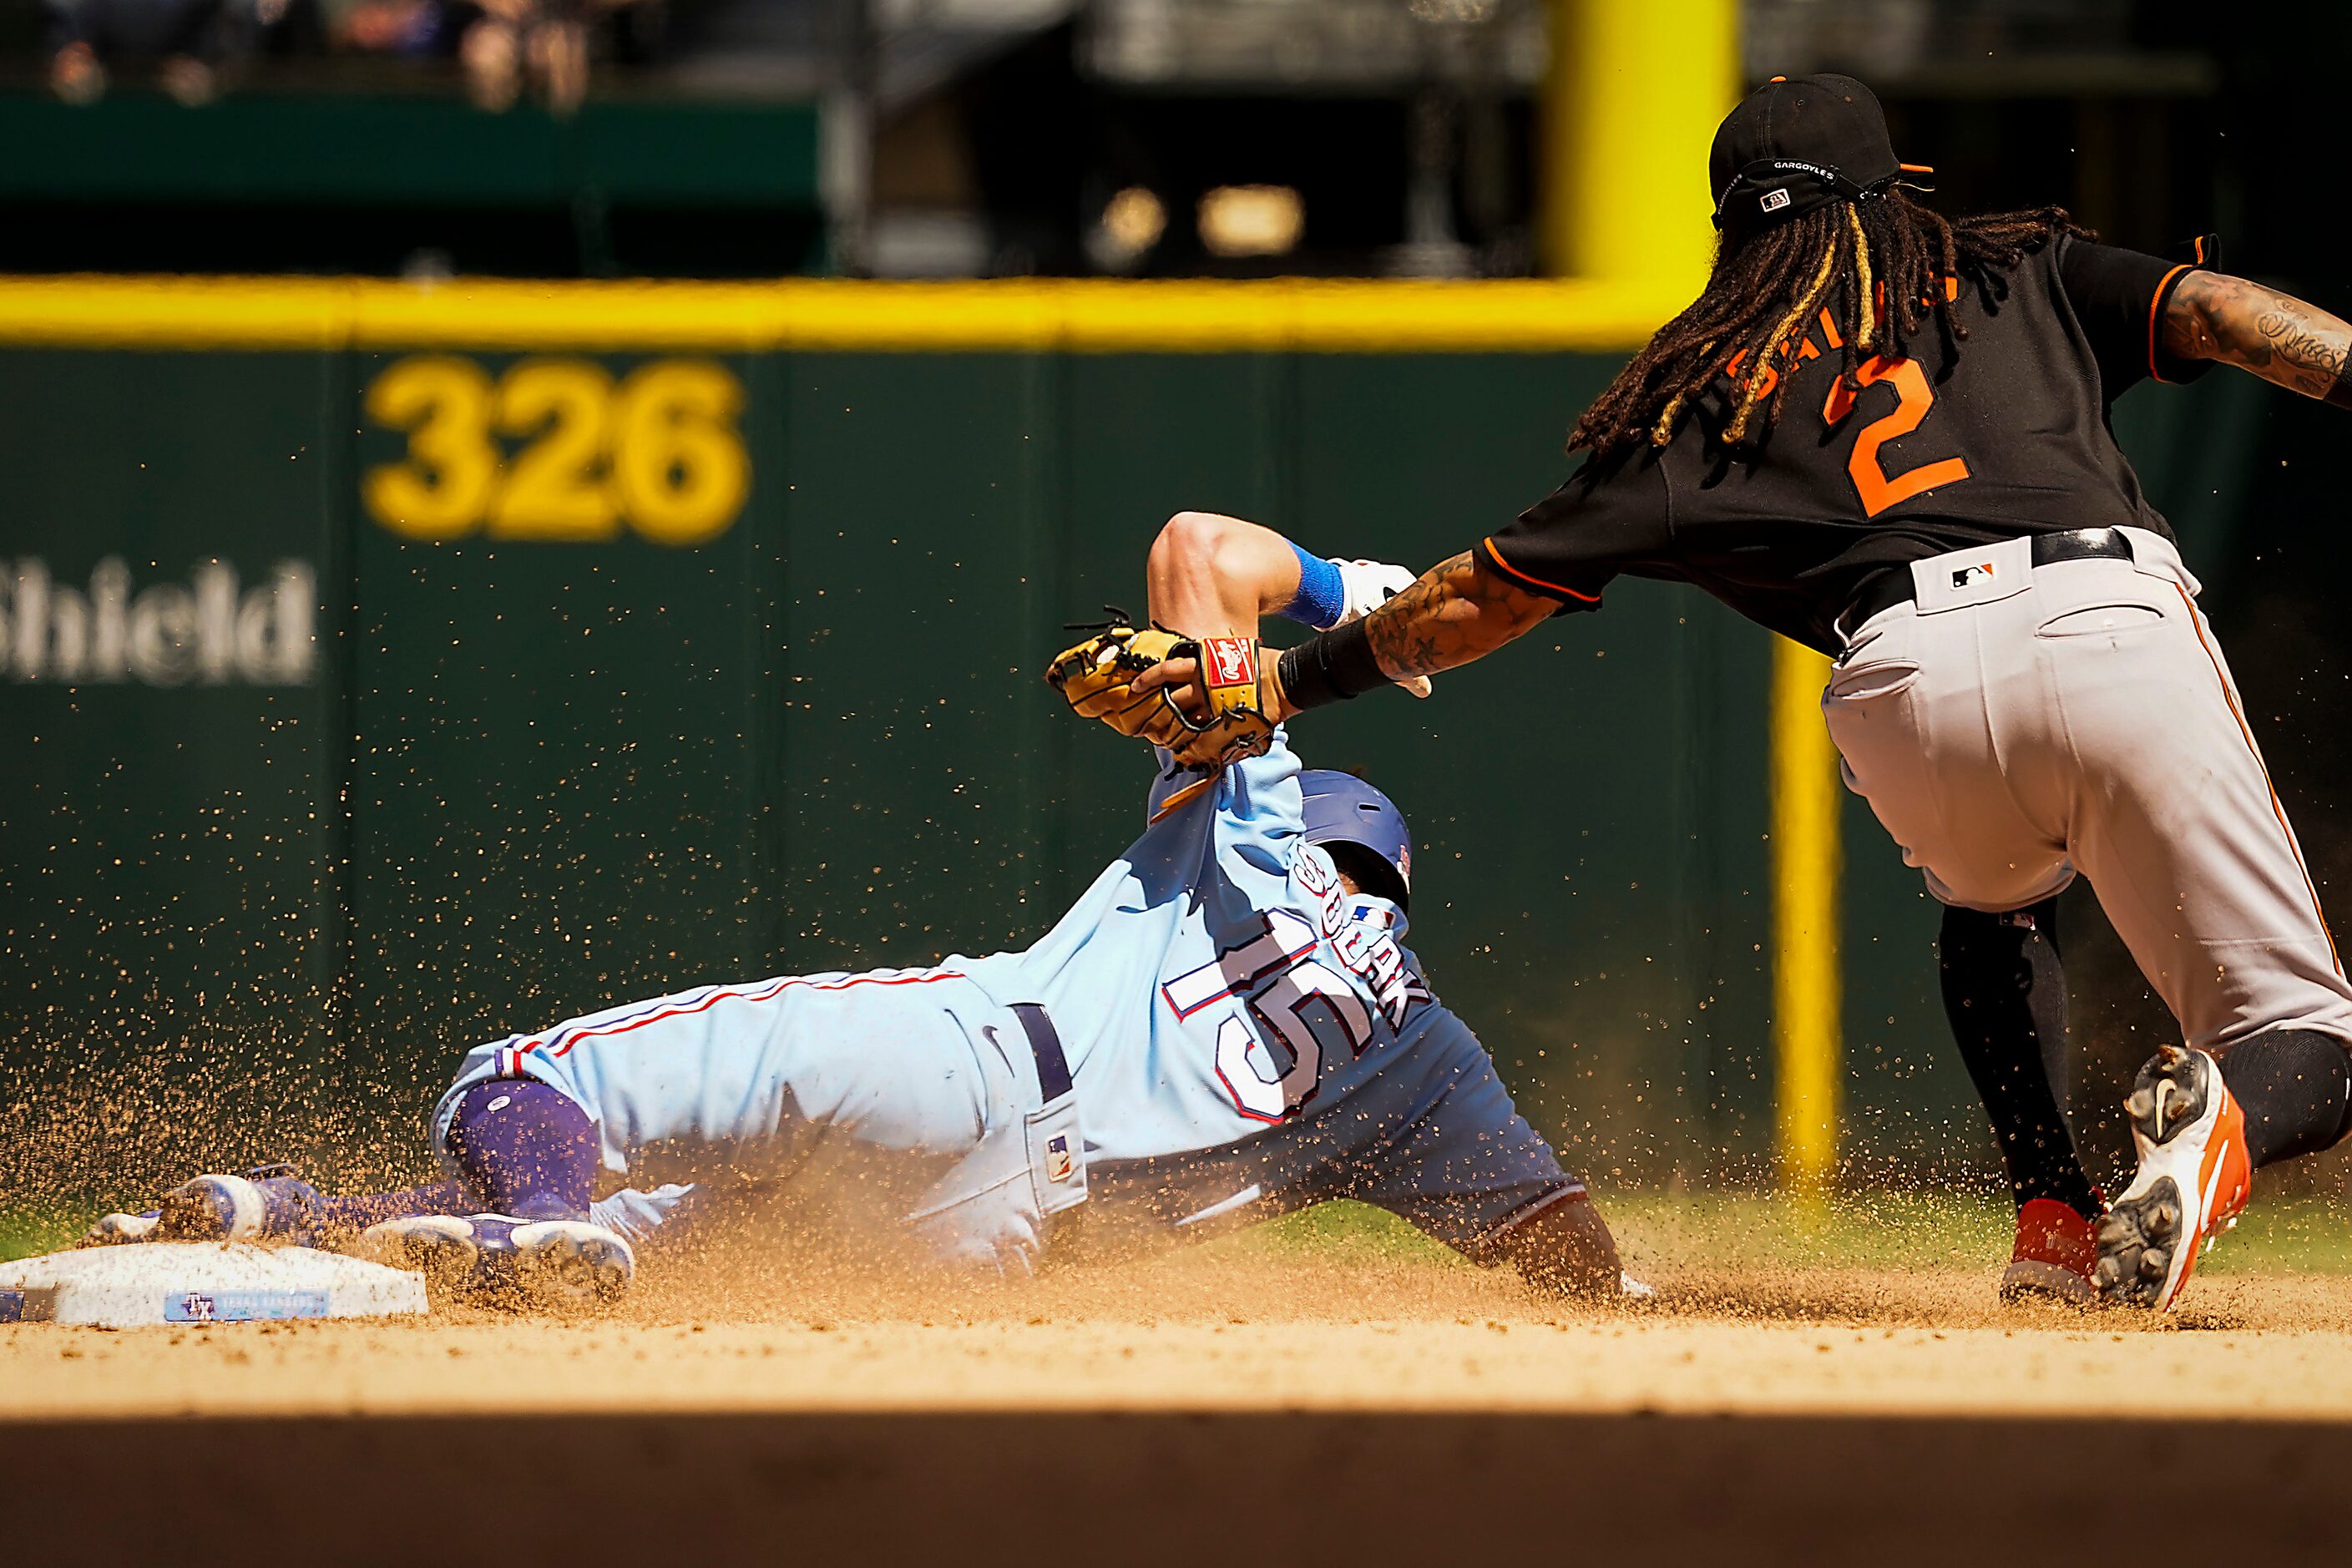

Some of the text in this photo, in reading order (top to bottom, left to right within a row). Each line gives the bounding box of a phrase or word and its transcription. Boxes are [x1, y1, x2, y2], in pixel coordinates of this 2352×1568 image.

[1774, 161, 1834, 180] GARGOYLES
[362, 354, 753, 546] 326
[1821, 352, 1973, 519] 2
[0, 552, 316, 687] hield
[1161, 907, 1374, 1125] 15
[1293, 842, 1434, 1038] SOLAK
